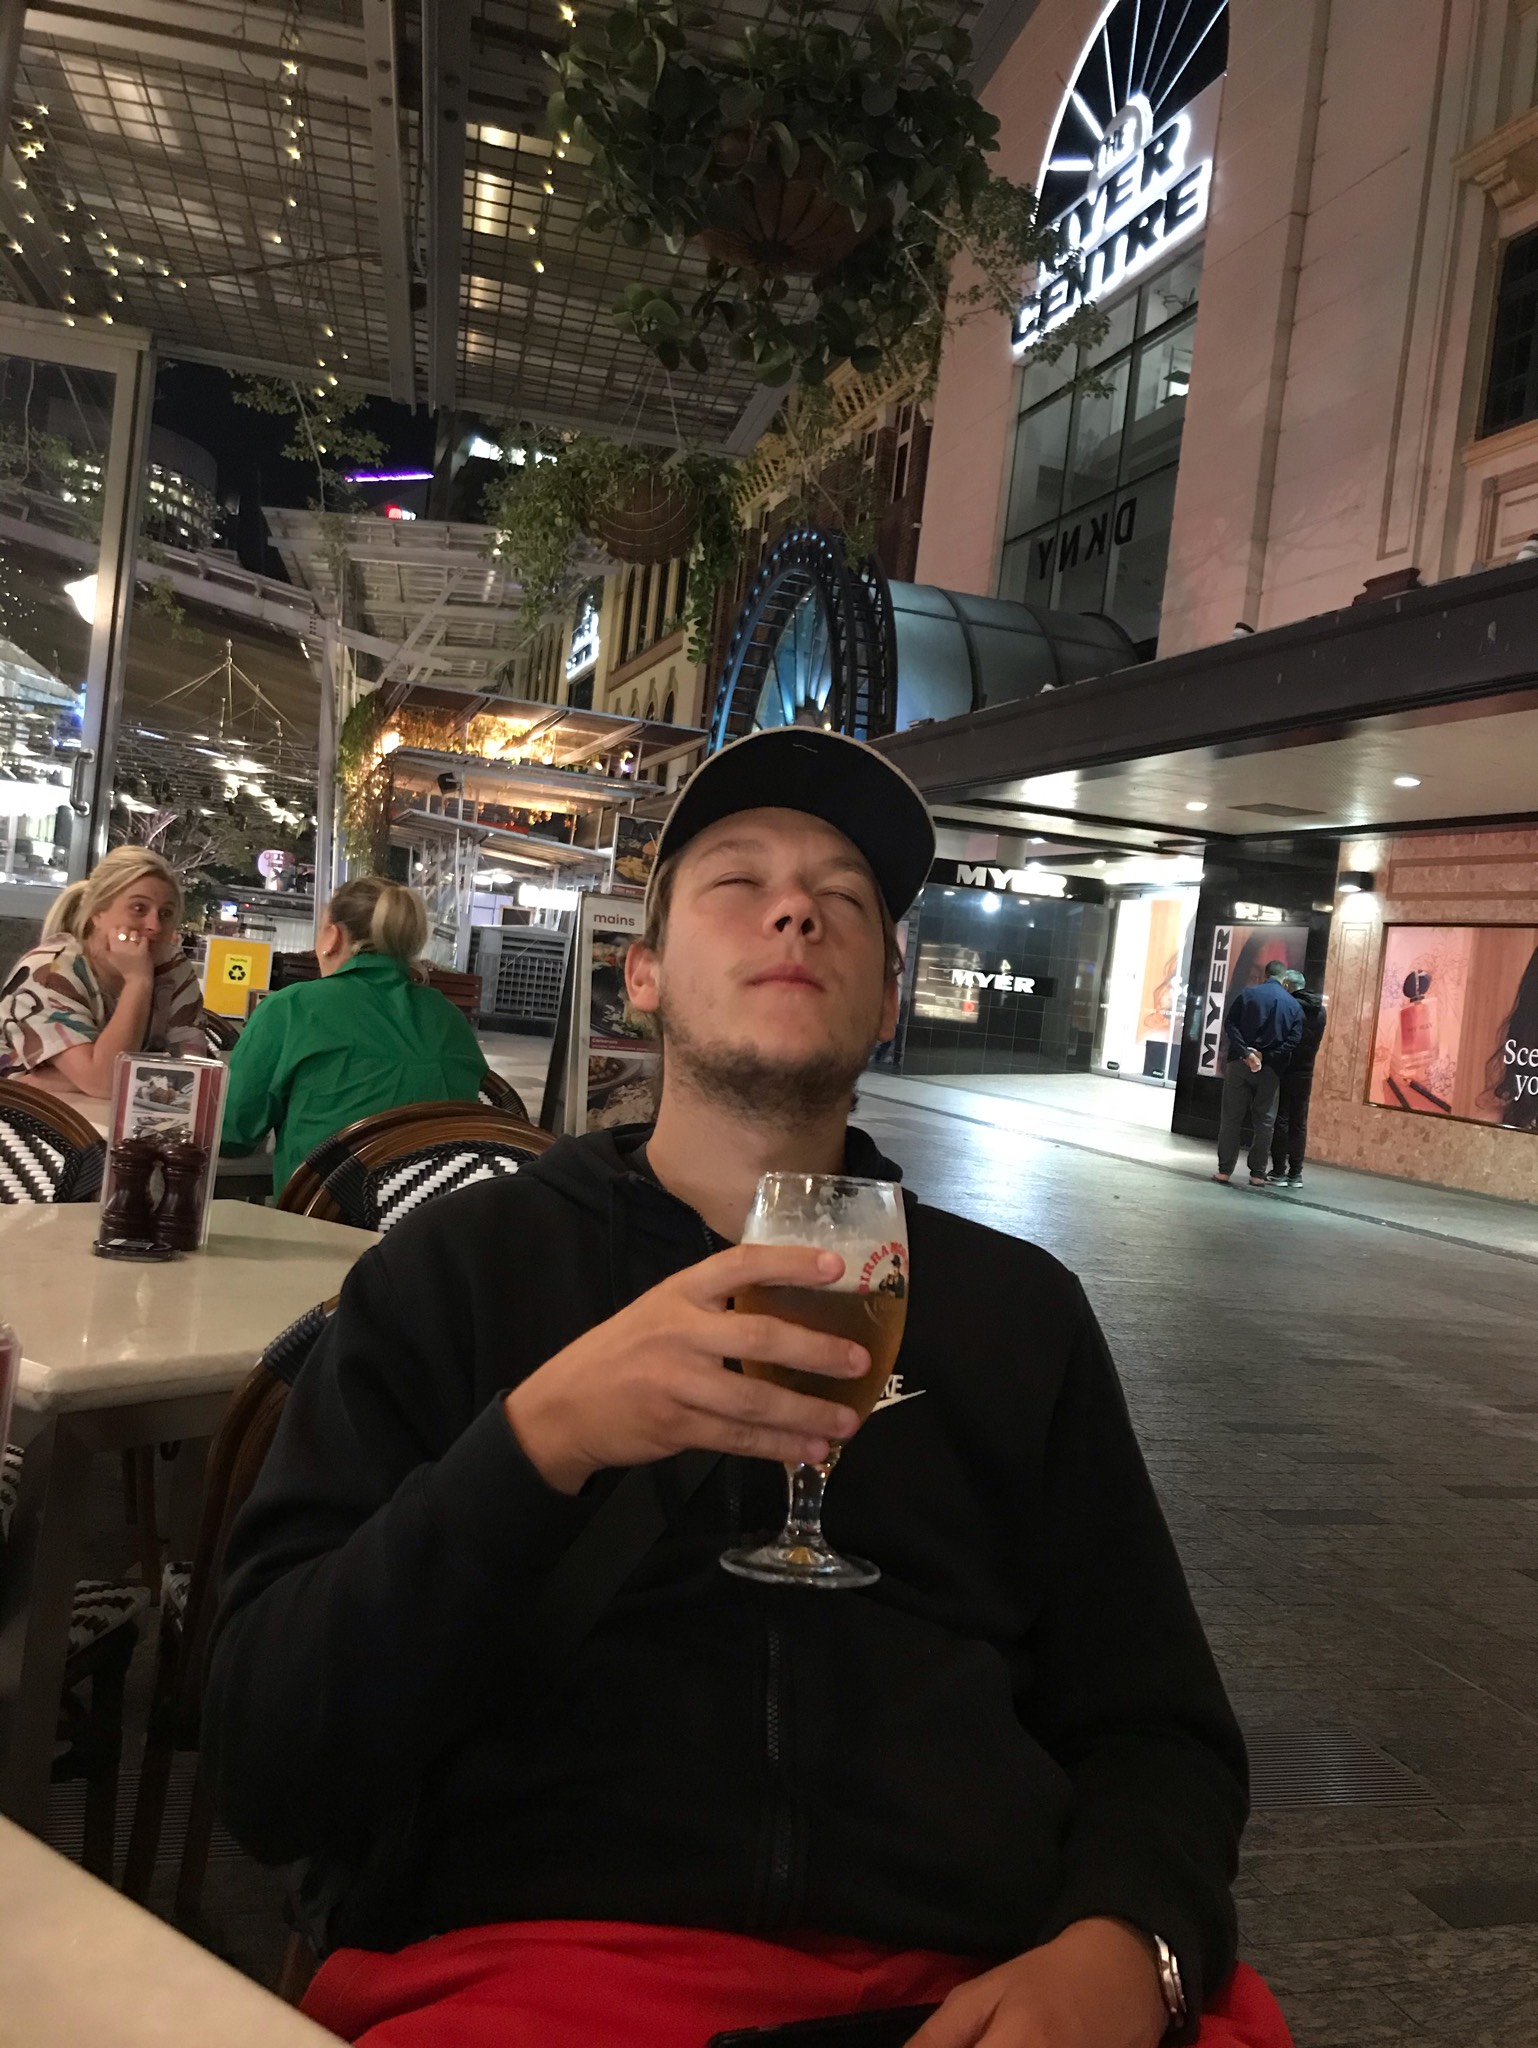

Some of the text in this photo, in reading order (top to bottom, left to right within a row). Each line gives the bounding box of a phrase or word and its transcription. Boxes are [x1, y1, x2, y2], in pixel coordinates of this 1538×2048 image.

[1011, 164, 1204, 346] CENTRE
[957, 863, 1068, 898] MYR
[593, 912, 635, 927] mains
[951, 969, 1036, 994] MYER
[1201, 927, 1231, 1069] MYER
[1503, 1039, 1538, 1068] Sce
[1514, 1074, 1538, 1102] yo
[857, 1244, 890, 1296] BIRRA
[880, 1374, 905, 1397] KE
